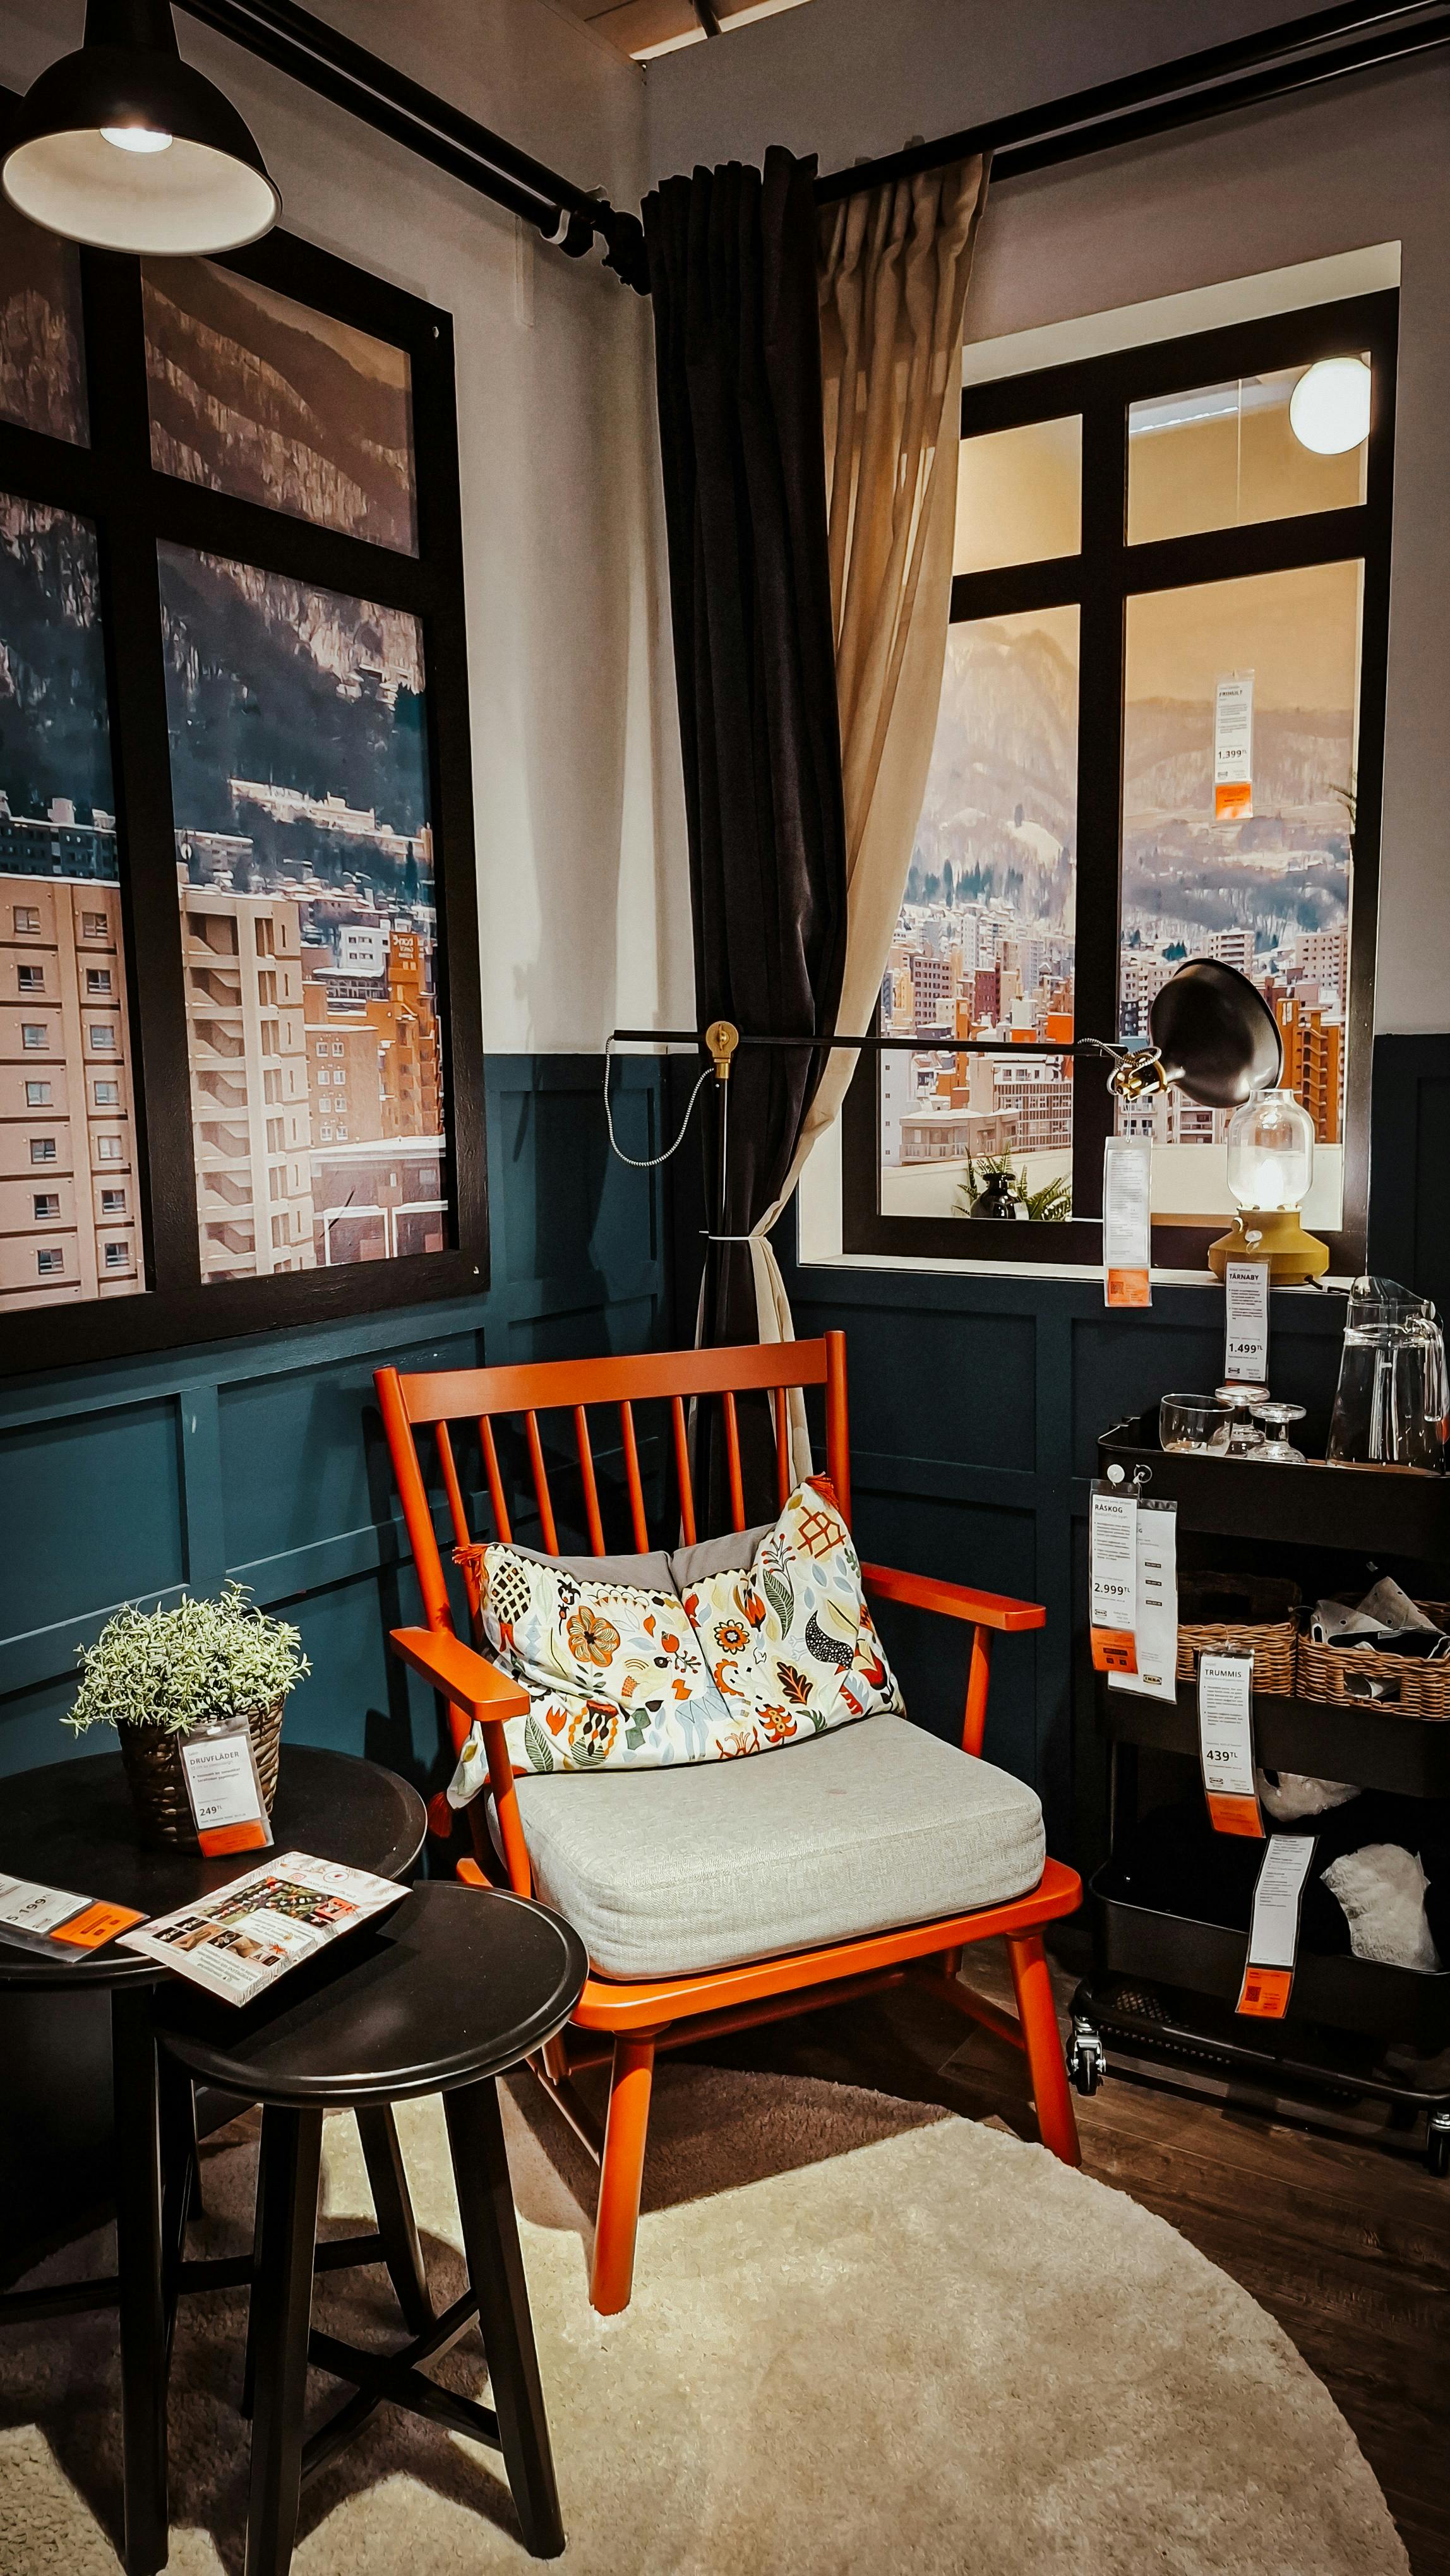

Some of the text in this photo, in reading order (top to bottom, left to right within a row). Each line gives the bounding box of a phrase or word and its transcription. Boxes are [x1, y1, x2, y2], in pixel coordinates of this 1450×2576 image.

[1094, 1504, 1123, 1513] RÅSKOG
[1204, 1669, 1242, 1678] TRUMMIS
[189, 1751, 239, 1765] DRUVFLÄDER
